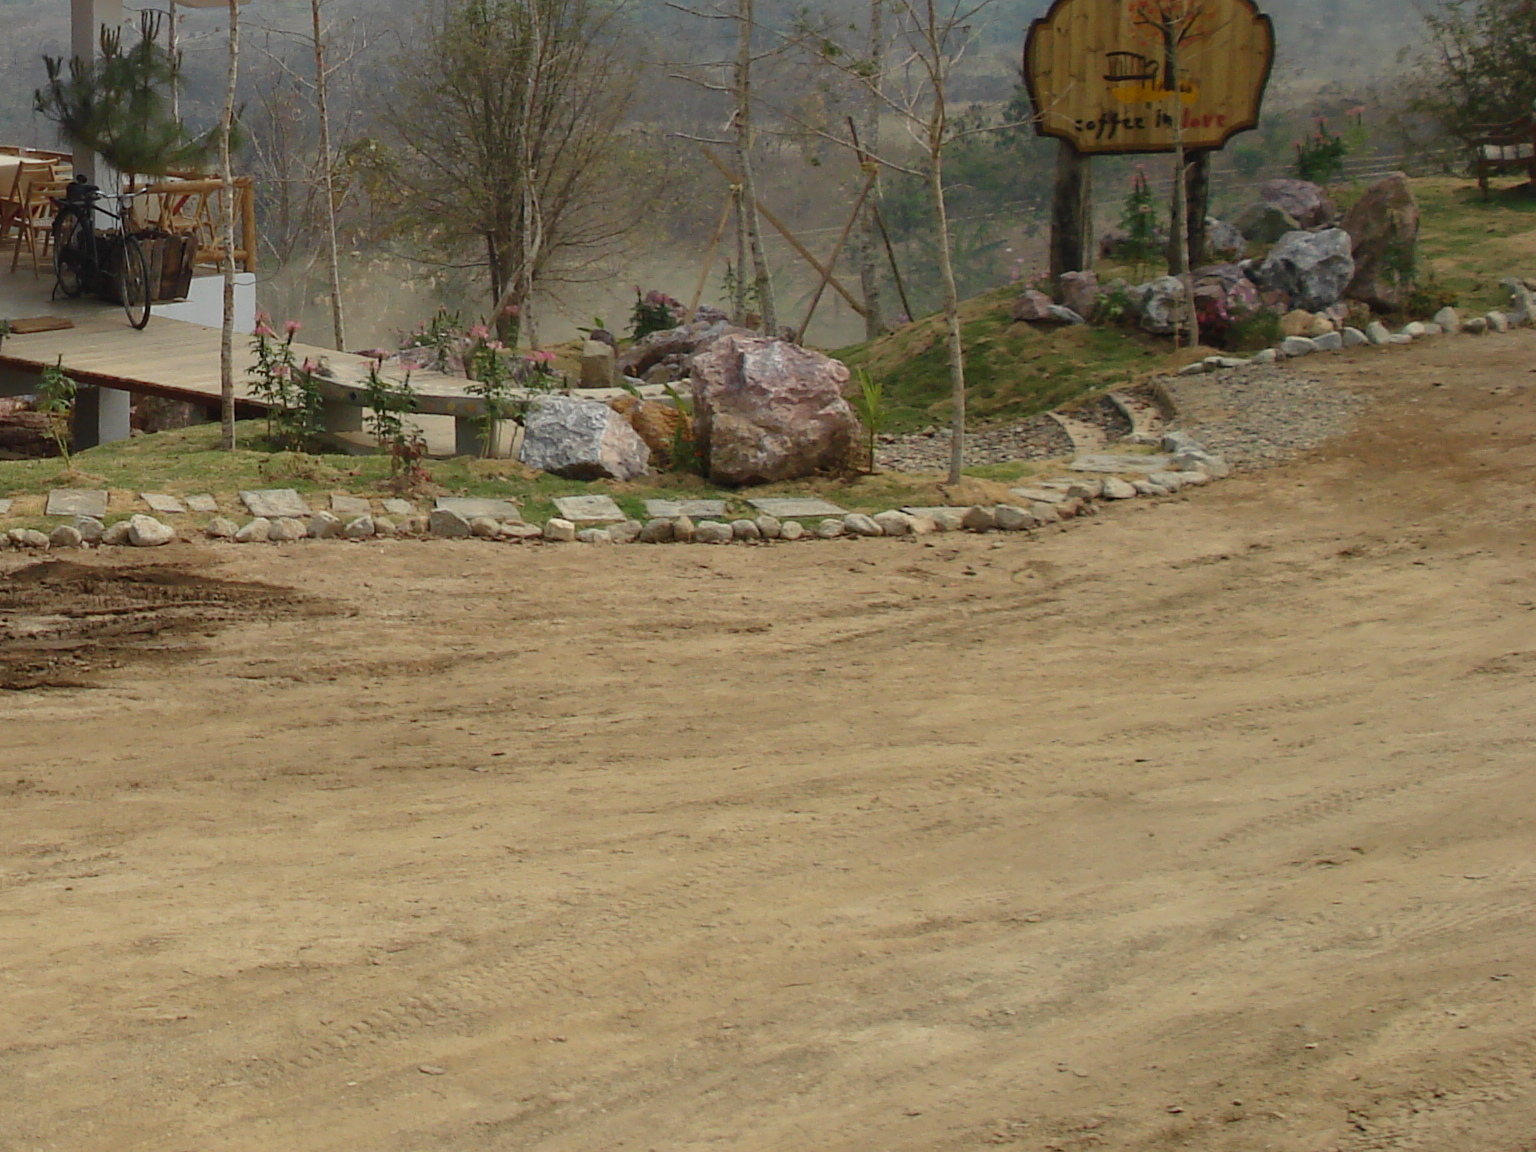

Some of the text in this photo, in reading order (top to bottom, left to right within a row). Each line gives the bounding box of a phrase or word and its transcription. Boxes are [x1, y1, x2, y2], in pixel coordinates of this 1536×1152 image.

[1075, 107, 1226, 139] coffee in love
